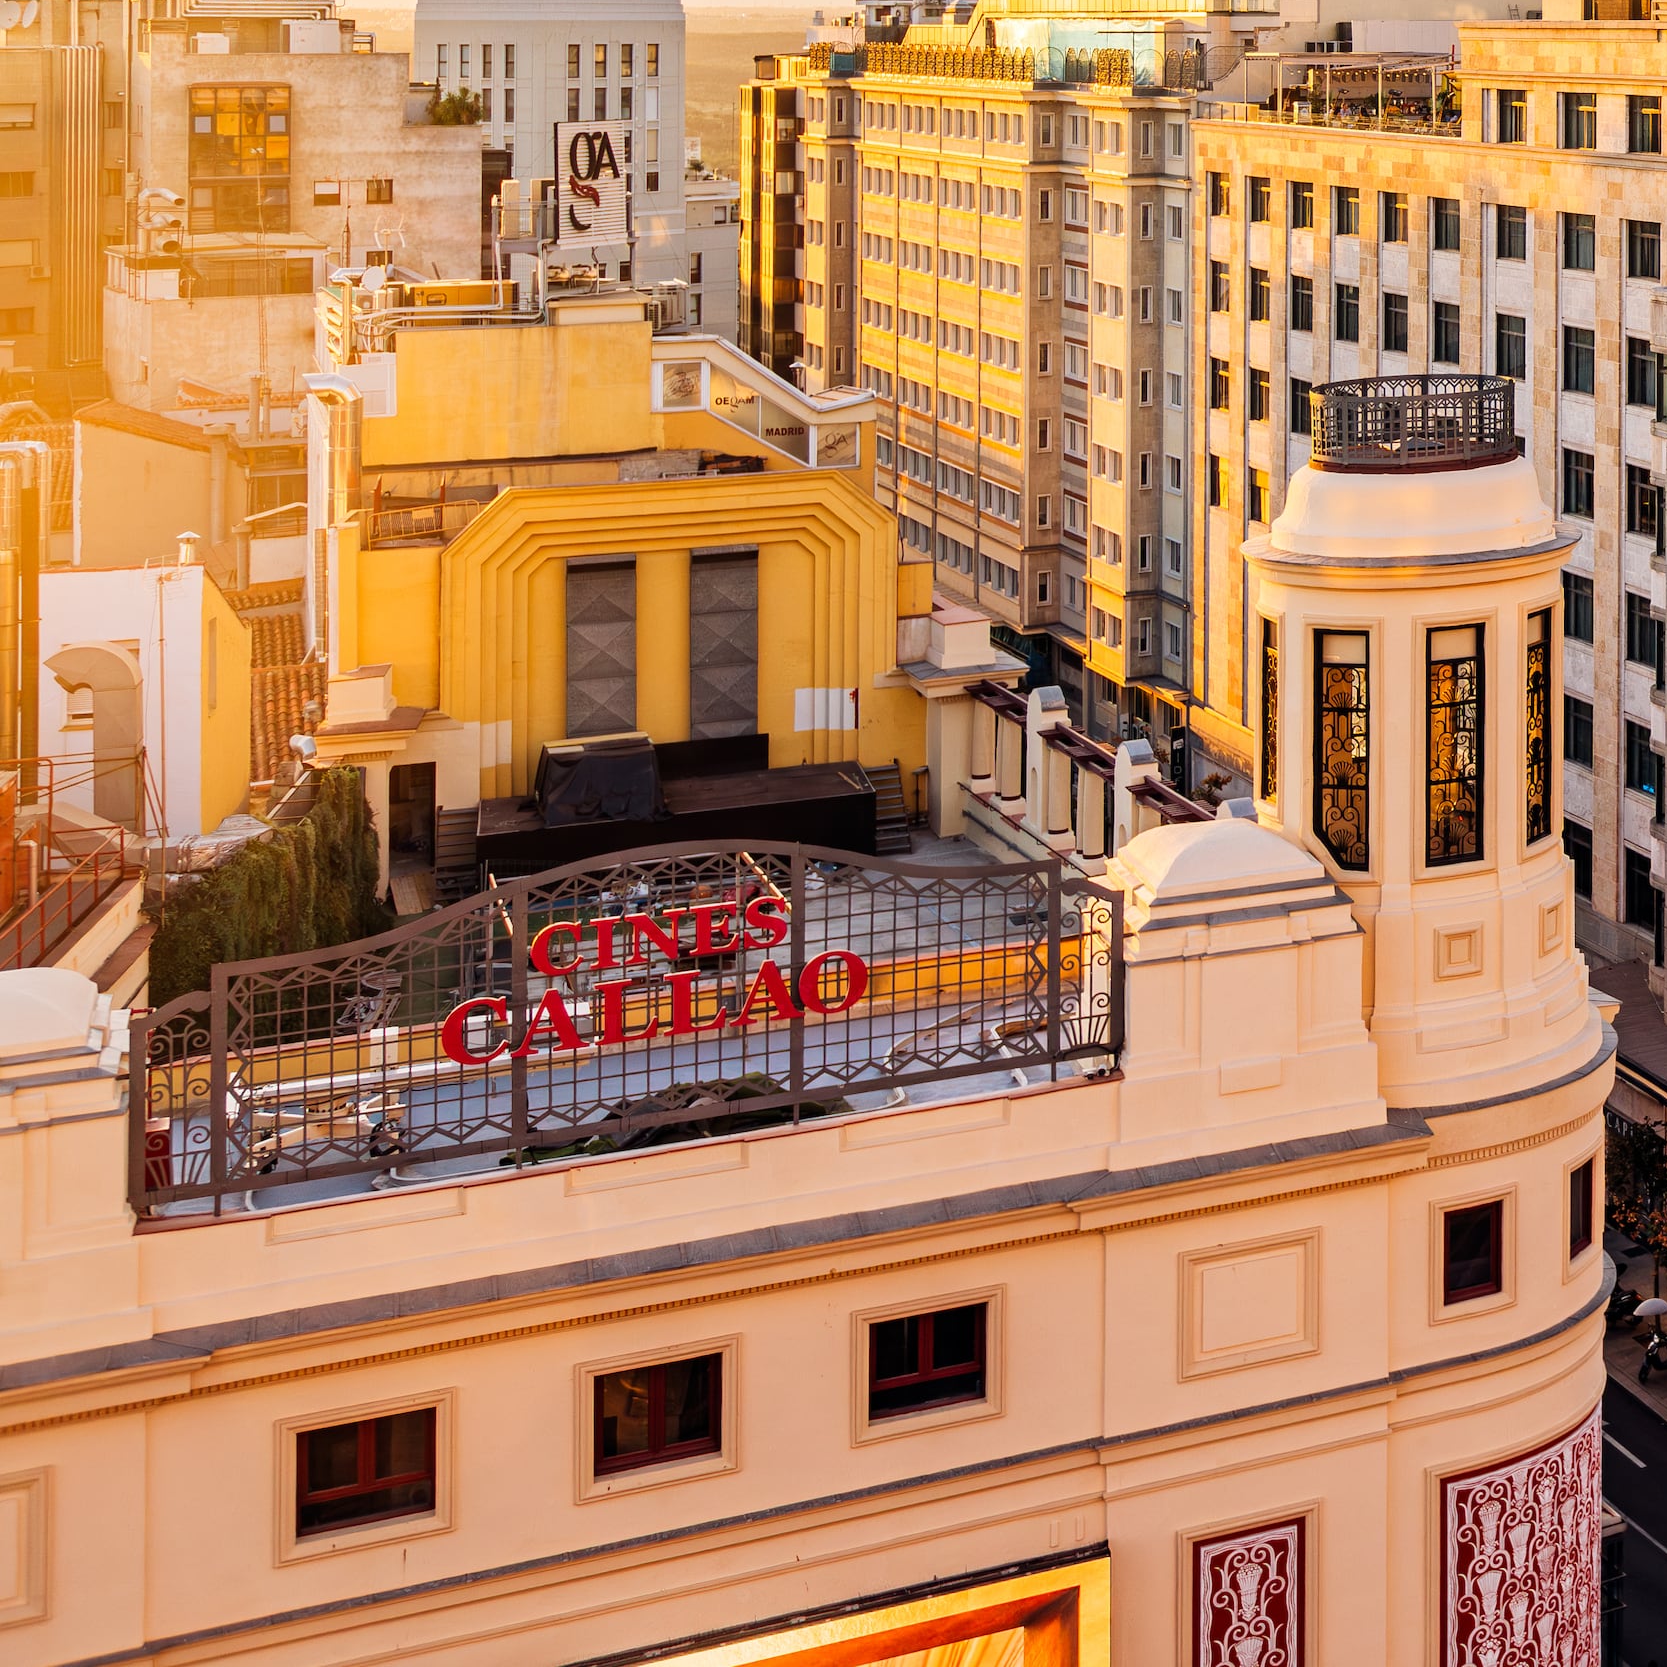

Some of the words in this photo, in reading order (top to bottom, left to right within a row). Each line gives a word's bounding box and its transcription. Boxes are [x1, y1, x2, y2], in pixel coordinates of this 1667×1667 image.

[765, 427, 805, 437] MADRID
[530, 896, 788, 976] CINES
[441, 949, 868, 1066] CALLAO
